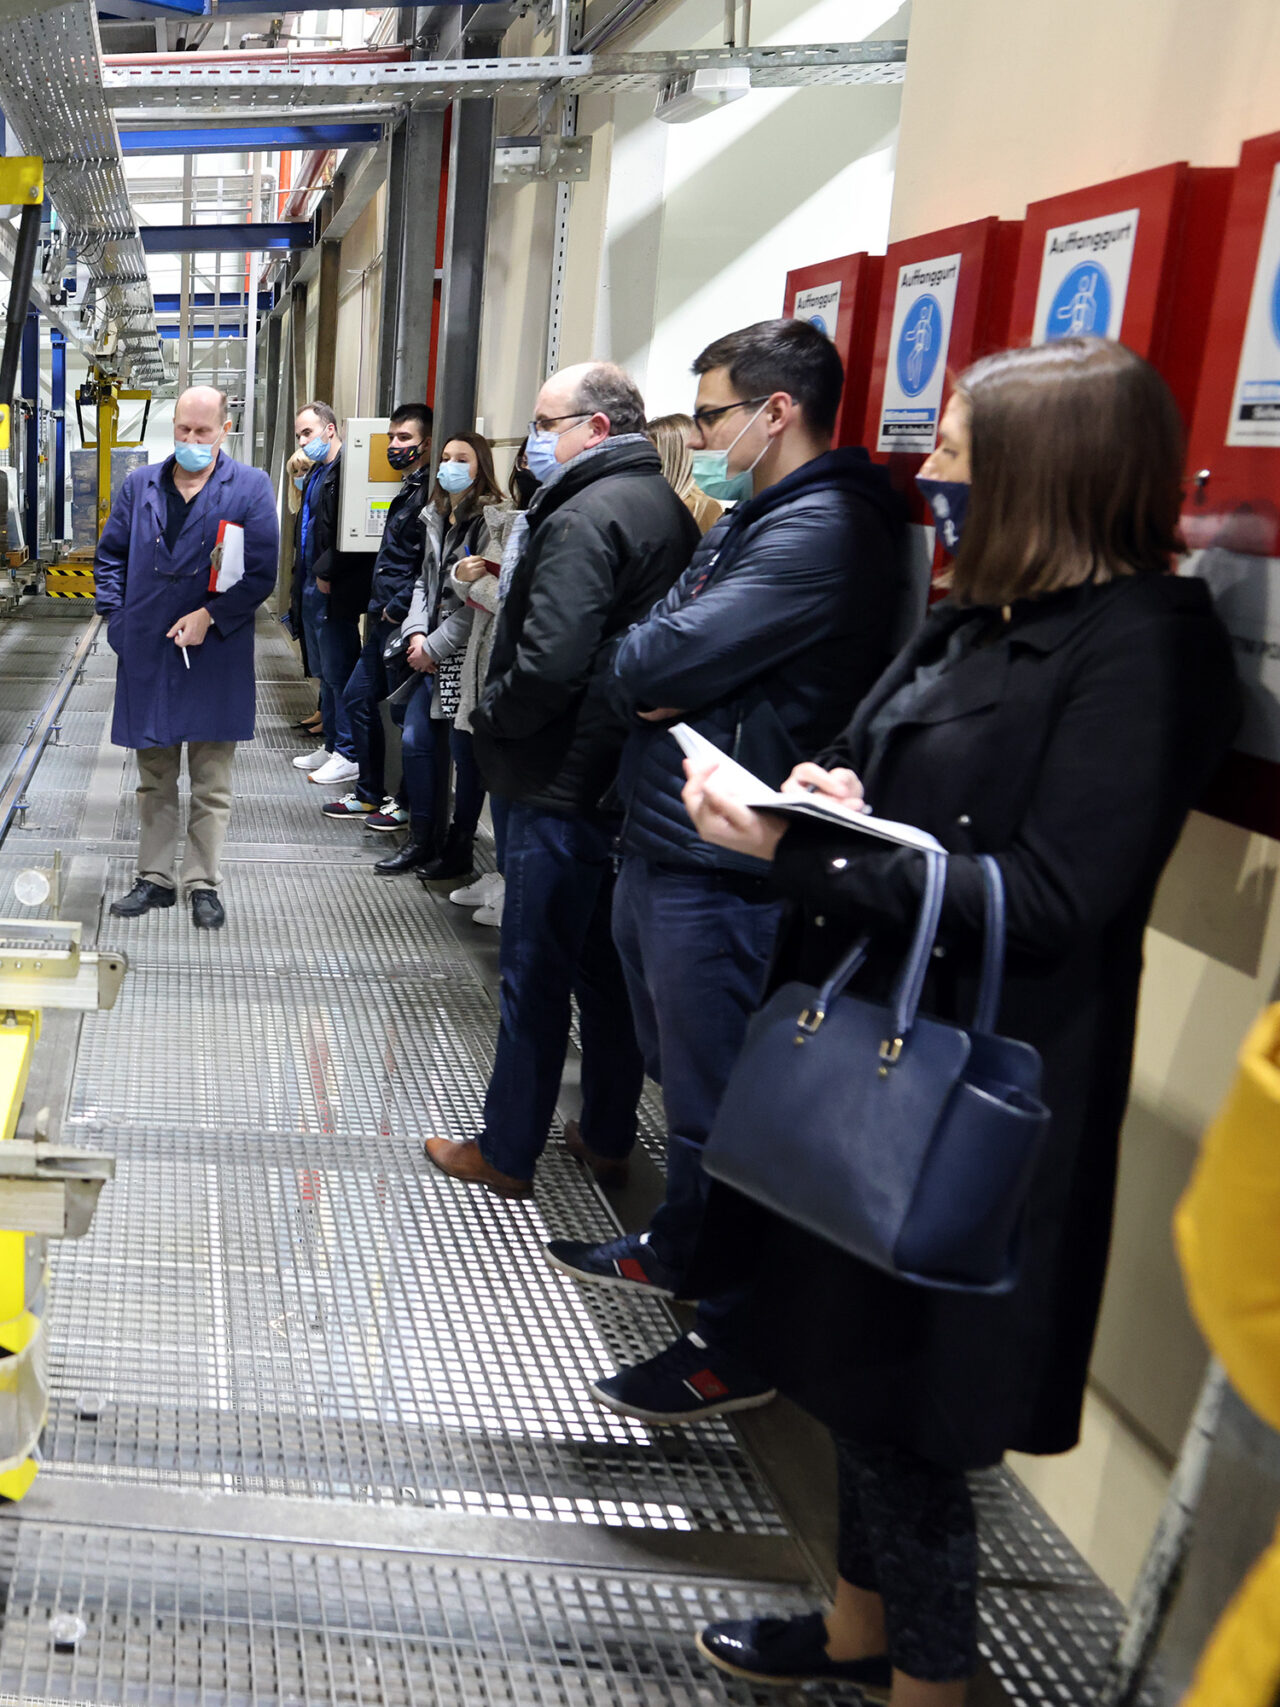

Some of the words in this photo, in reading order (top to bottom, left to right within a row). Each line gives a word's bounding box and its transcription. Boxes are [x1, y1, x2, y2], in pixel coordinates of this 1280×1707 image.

[1048, 223, 1131, 256] Auffanggurt
[901, 265, 956, 287] Auffanggurt
[797, 291, 838, 309] Auffanggurt
